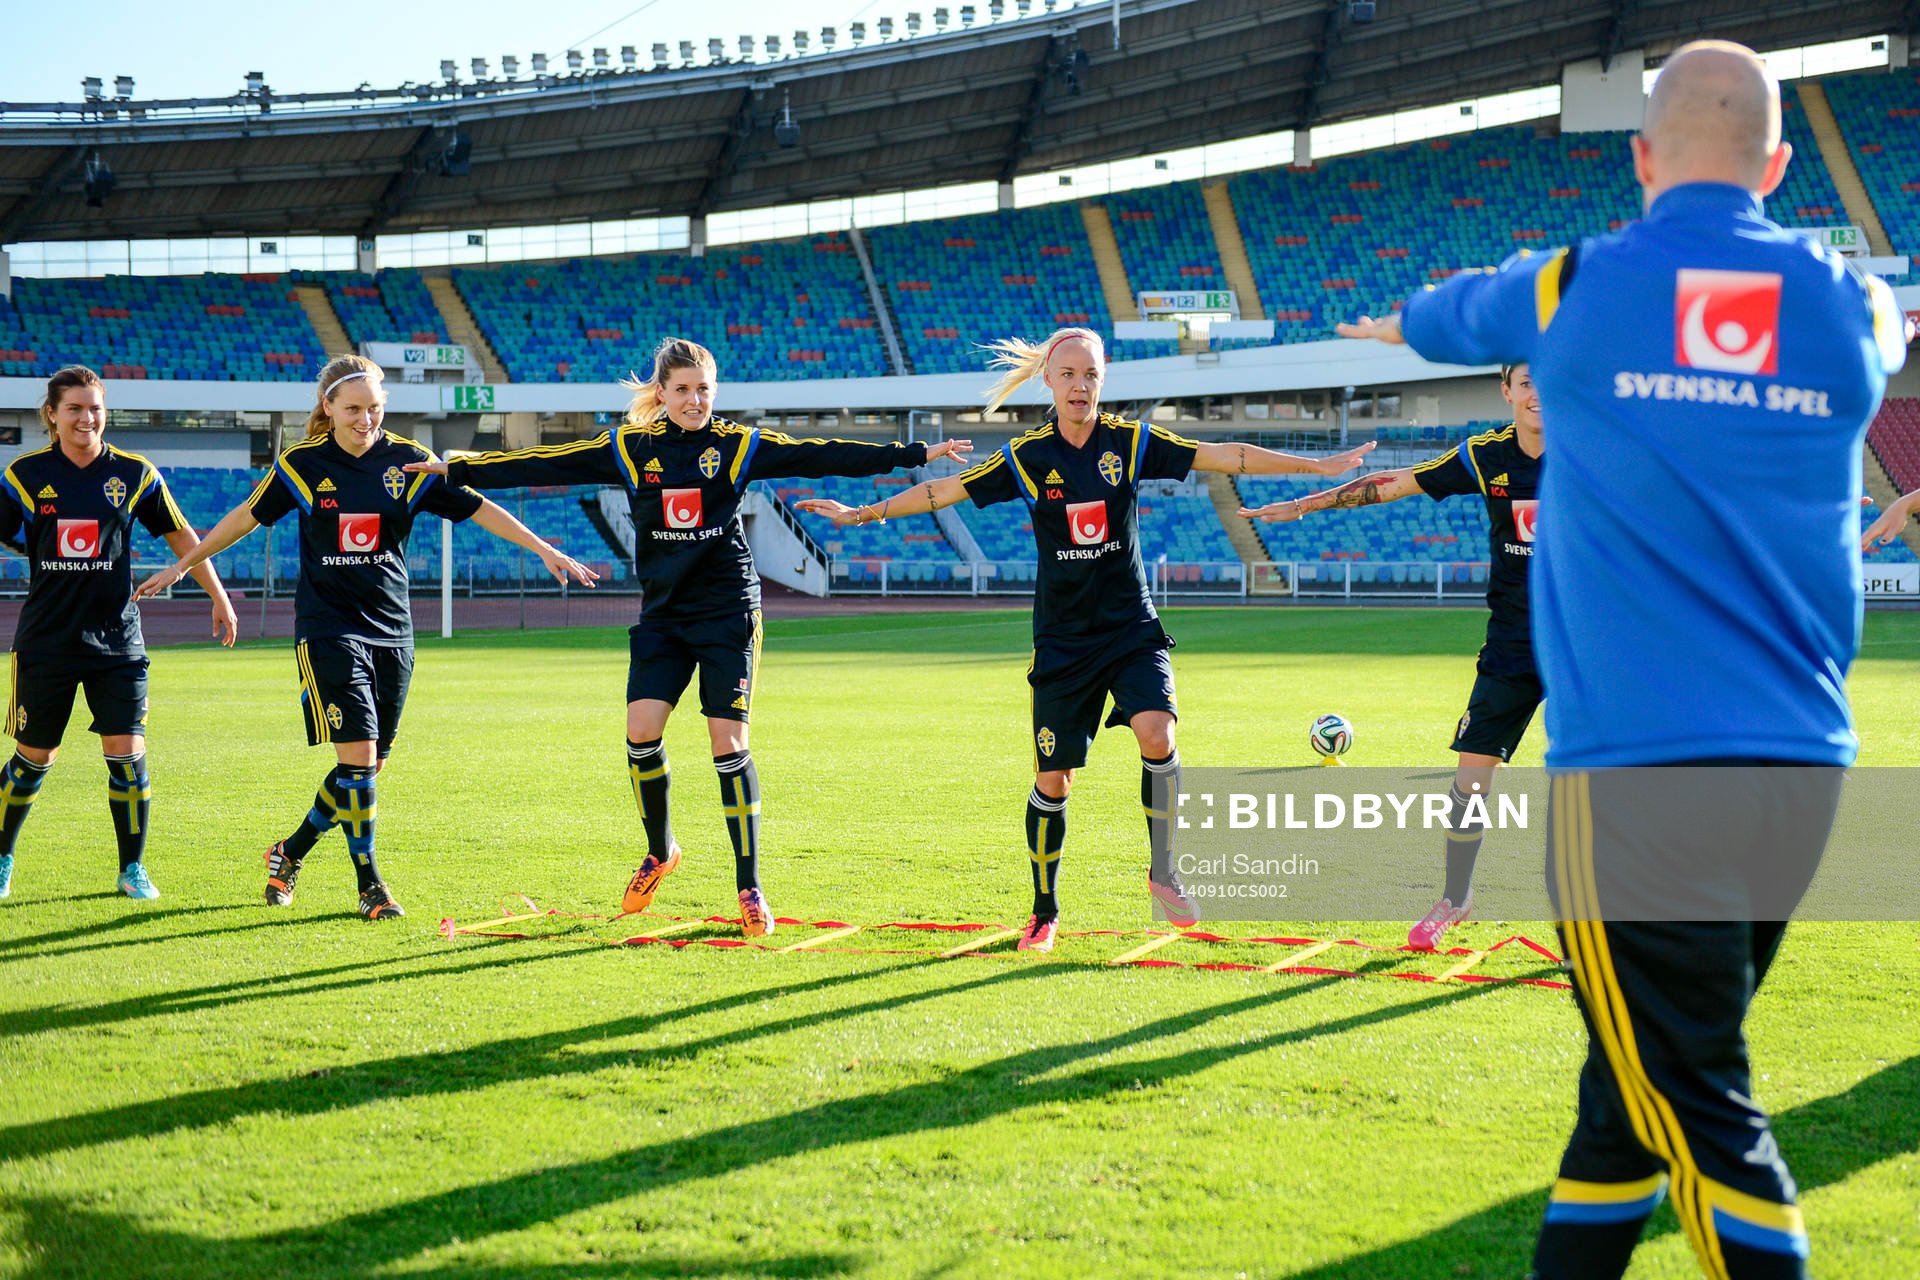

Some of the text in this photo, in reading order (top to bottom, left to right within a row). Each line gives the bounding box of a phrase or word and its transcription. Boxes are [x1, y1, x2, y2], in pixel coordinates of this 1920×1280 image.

[1614, 371, 1832, 417] SVENSKA SPEL
[645, 473, 661, 483] ICA
[1046, 488, 1064, 500] ICA
[1490, 486, 1508, 497] ICA
[40, 503, 57, 514] ICA
[320, 498, 339, 508] ICA
[651, 526, 724, 541] SVENSKA SPEL
[1056, 548, 1101, 560] SVENSKA
[1504, 543, 1534, 556] SVENS
[41, 561, 90, 571] SVENSKA
[321, 555, 371, 566] SVENSKA
